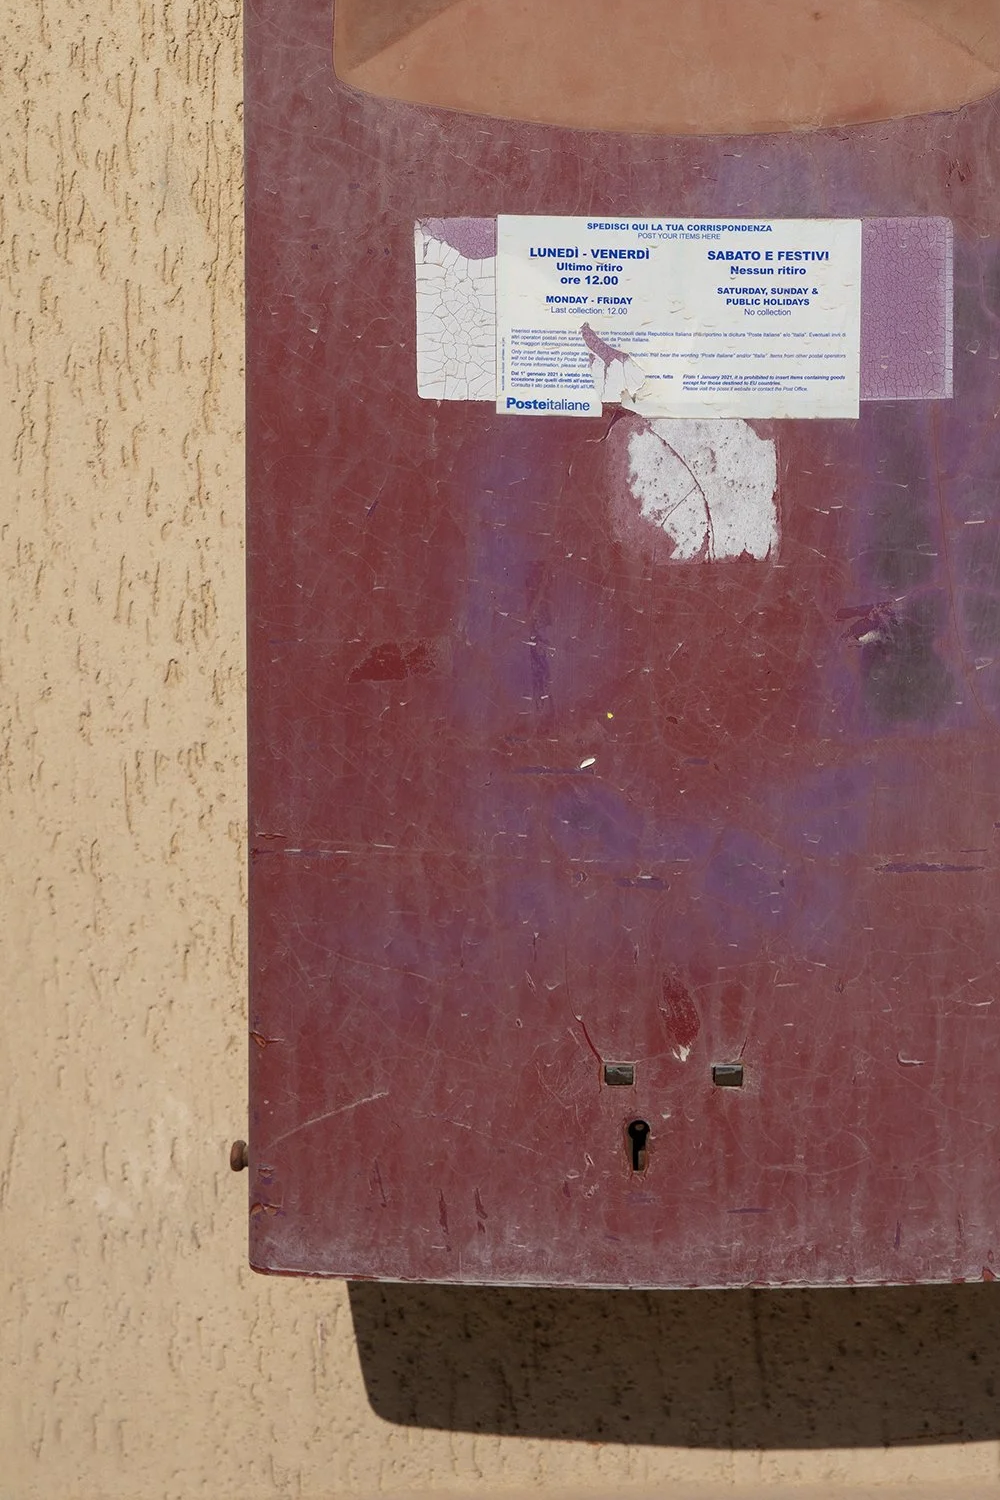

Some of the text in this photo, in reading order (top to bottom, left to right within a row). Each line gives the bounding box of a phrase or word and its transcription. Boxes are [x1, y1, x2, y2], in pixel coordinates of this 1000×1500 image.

[587, 222, 629, 230] SPEDISCI
[632, 224, 648, 232] QUI
[529, 246, 579, 258] LUNEDÌ
[590, 248, 650, 260] VENERDÌ
[707, 250, 829, 261] SABATO E FESTIVI
[556, 262, 623, 272] Ultimo ritiro
[730, 266, 806, 275] Nessun ritiro
[585, 276, 618, 285] 12.00
[717, 287, 768, 296] SATURDAY,
[546, 295, 588, 304] MONDAY
[597, 296, 633, 305] FRIDAY
[568, 306, 605, 315] collection:
[506, 397, 590, 411] Posteitaliane
